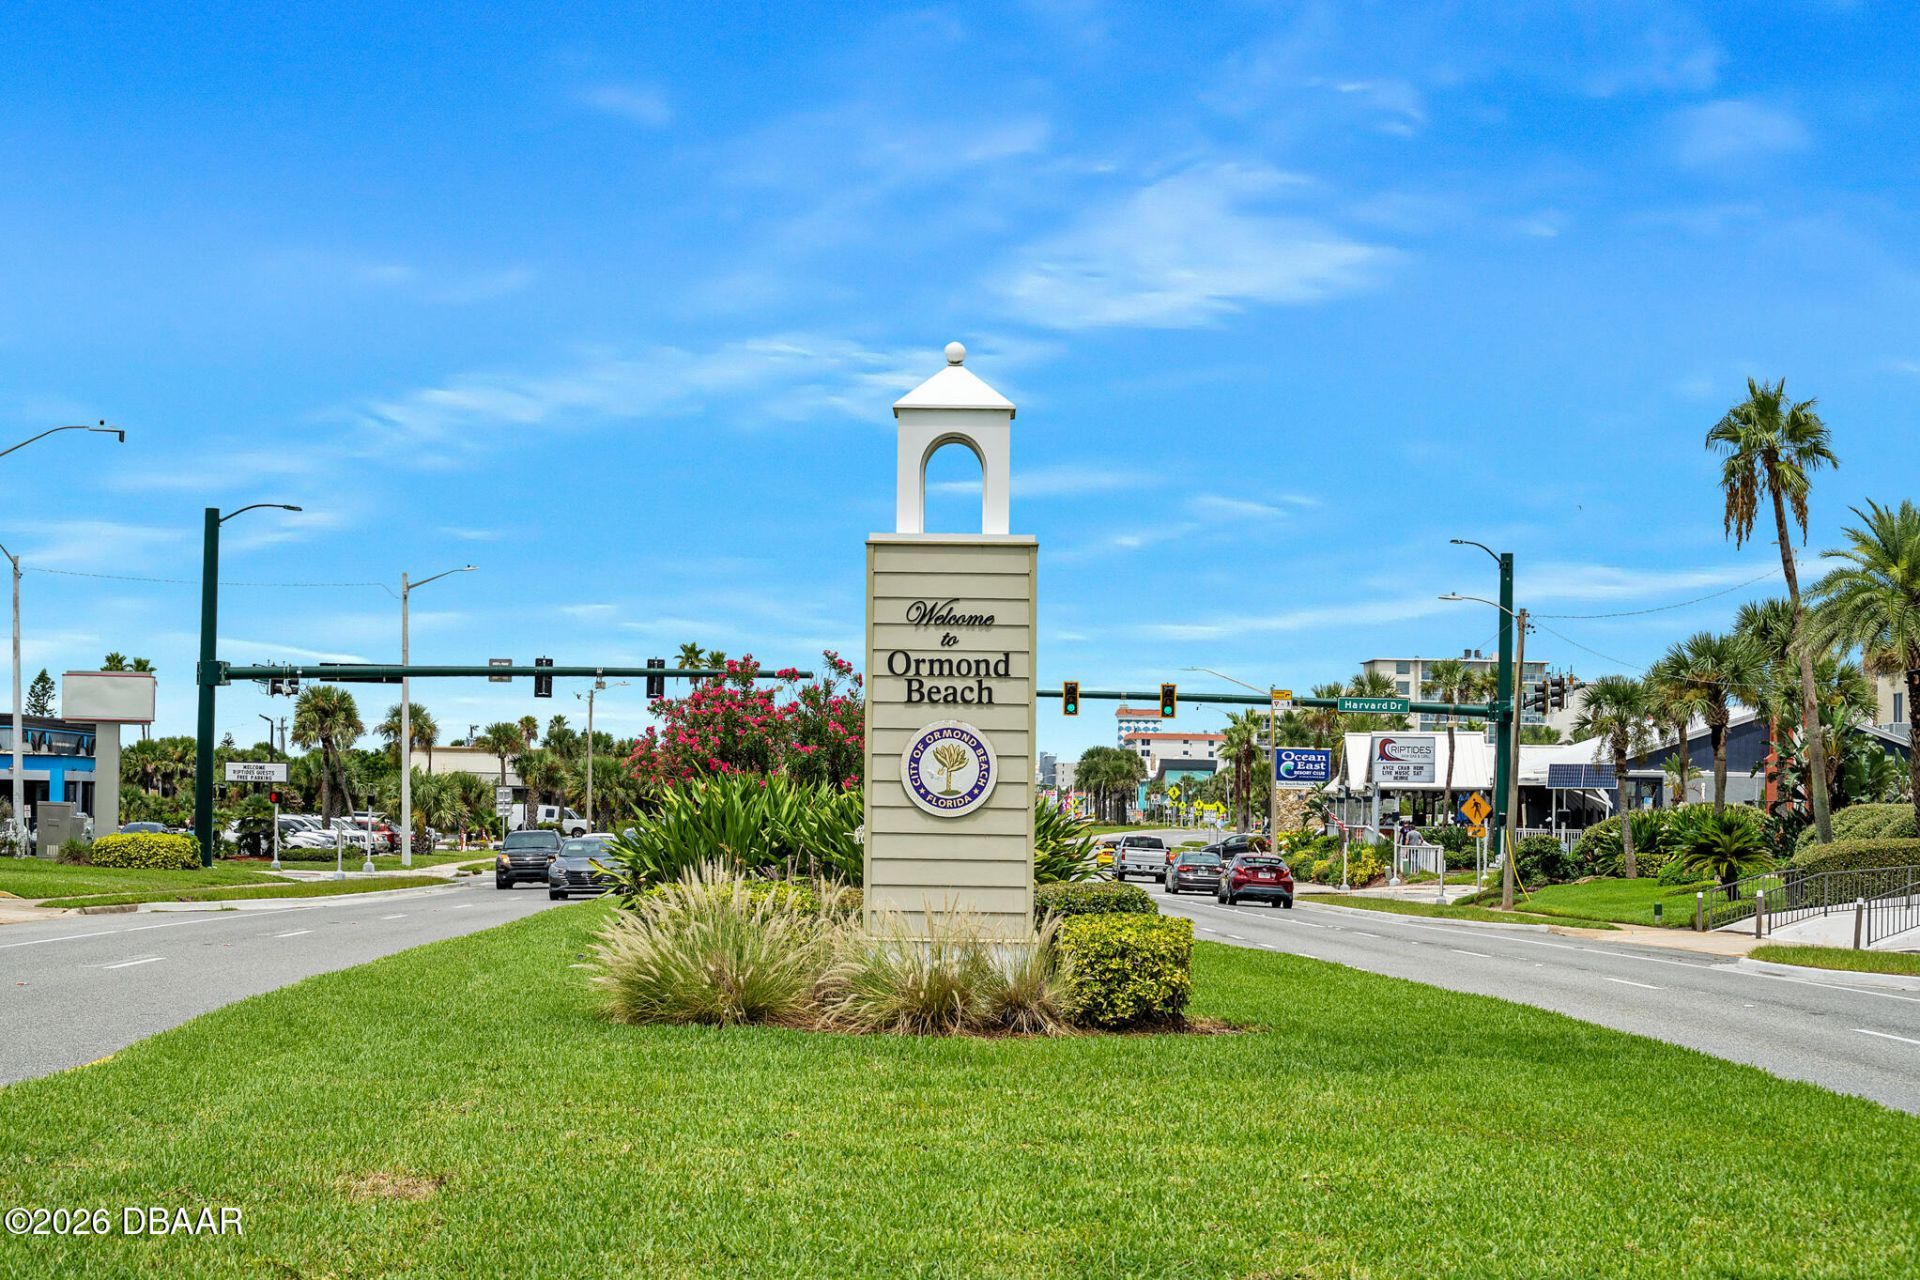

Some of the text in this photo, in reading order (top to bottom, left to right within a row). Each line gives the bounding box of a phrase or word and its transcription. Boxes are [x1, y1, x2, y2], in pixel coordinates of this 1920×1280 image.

[906, 598, 995, 626] Welcome
[940, 632, 959, 647] to
[887, 650, 1011, 677] Ormond
[904, 678, 995, 704] Beach
[1344, 700, 1402, 710] Harvard Dr
[1281, 751, 1327, 761] Ocean
[1390, 745, 1432, 755] RIPTIDES
[910, 729, 988, 787] CITY OF ORMOND BEACH
[1296, 761, 1326, 770] East
[926, 795, 972, 808] FLORIDA
